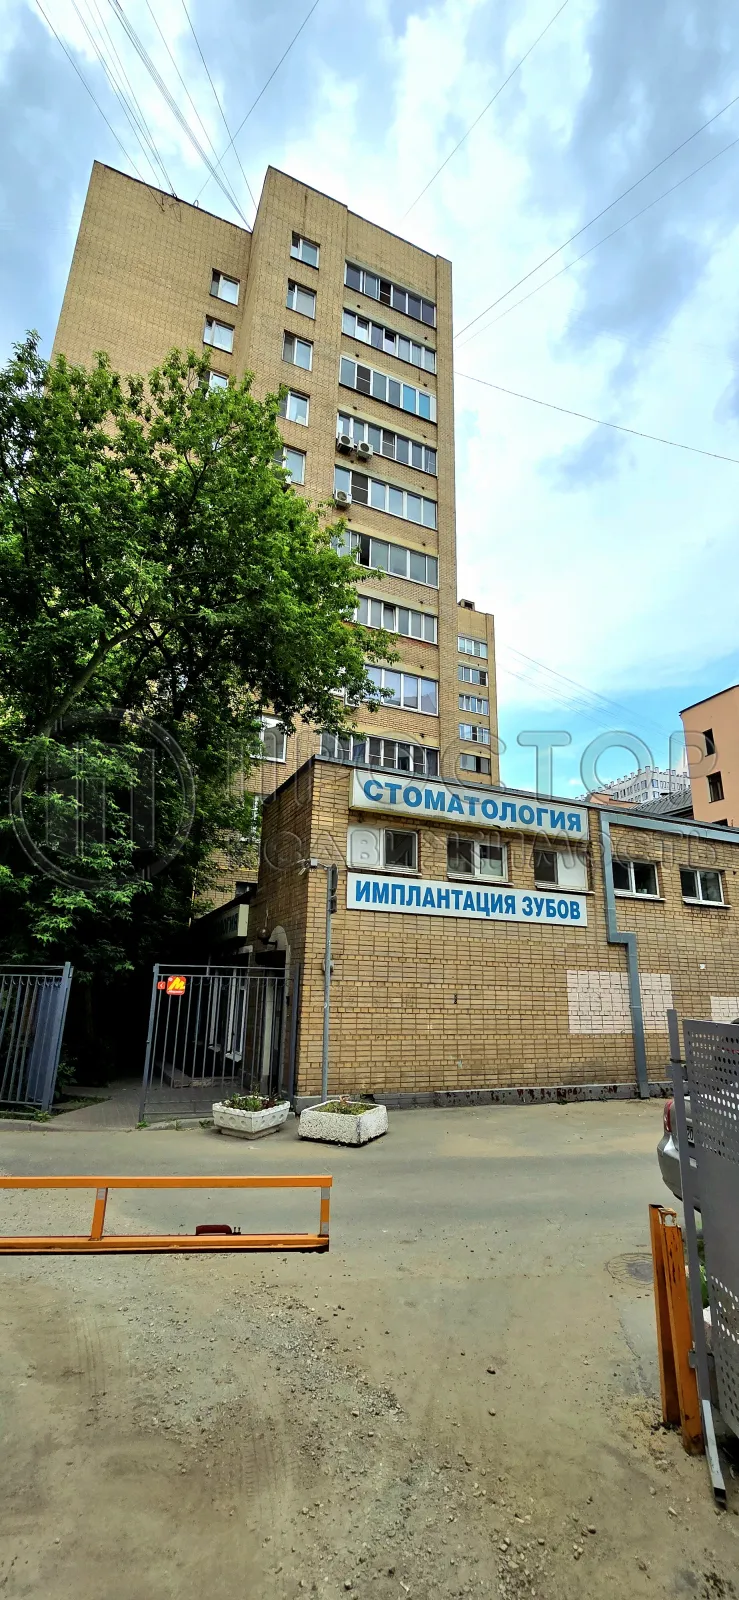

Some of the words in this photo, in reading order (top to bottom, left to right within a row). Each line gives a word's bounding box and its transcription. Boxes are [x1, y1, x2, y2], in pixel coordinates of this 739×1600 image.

[363, 779, 582, 833] СТОМАТОЛОГИЯ
[355, 880, 517, 917] ИМПЛАНТАЦИЯ
[522, 896, 581, 920] ЗУБОВ
